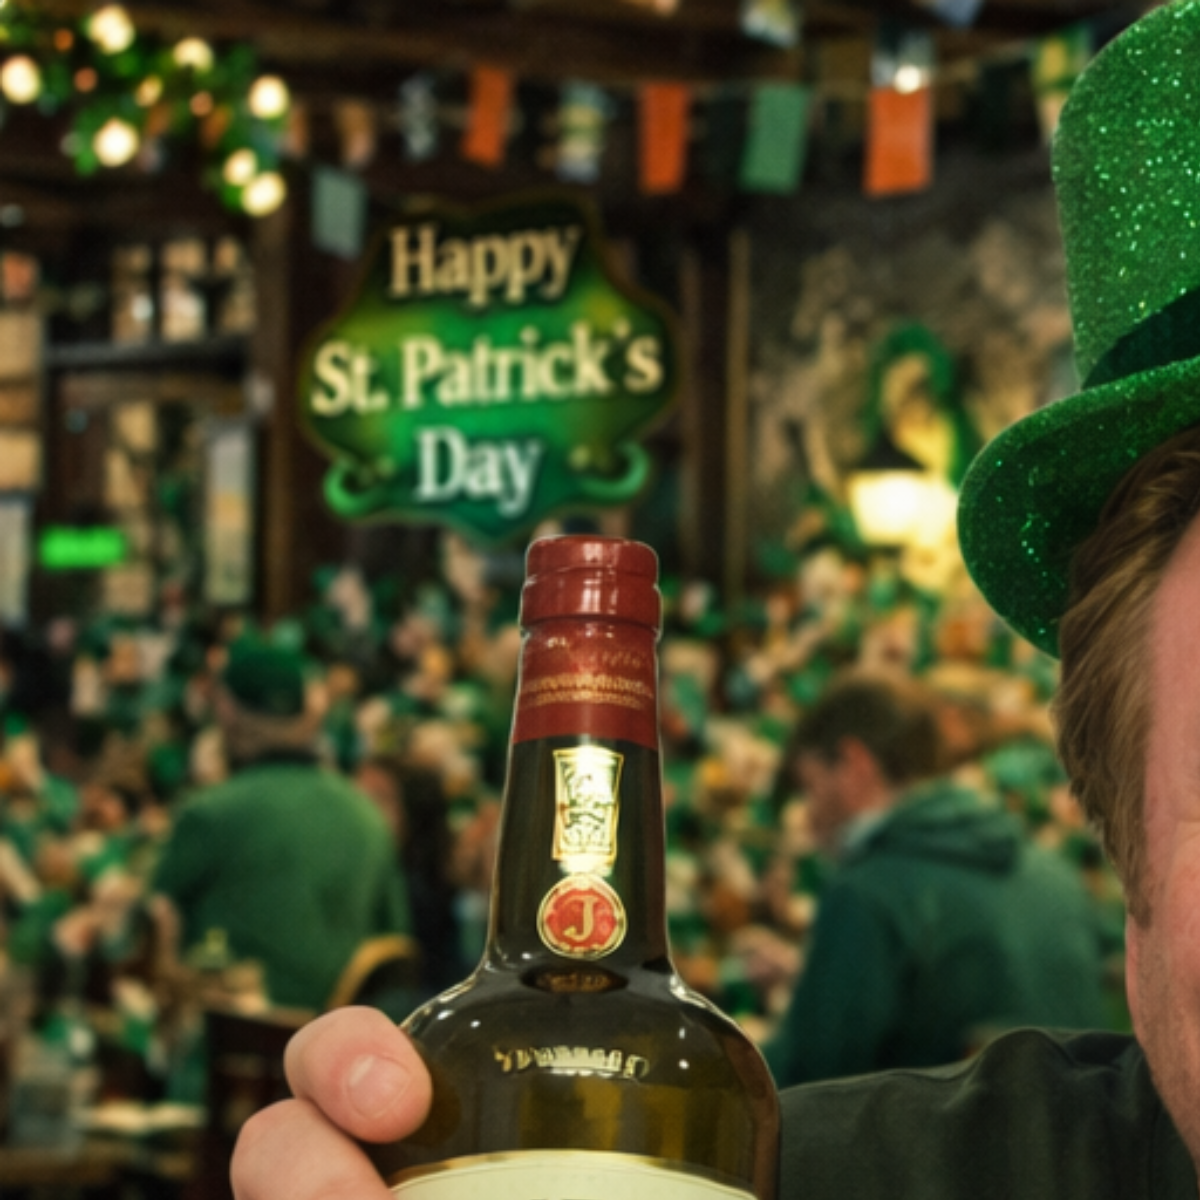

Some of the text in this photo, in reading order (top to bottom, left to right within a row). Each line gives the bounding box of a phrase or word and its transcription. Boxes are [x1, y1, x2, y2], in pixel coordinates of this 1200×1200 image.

[390, 224, 580, 305] Happy
[310, 319, 664, 415] St. Patrick's
[415, 426, 542, 517] Day
[563, 895, 598, 941] J
